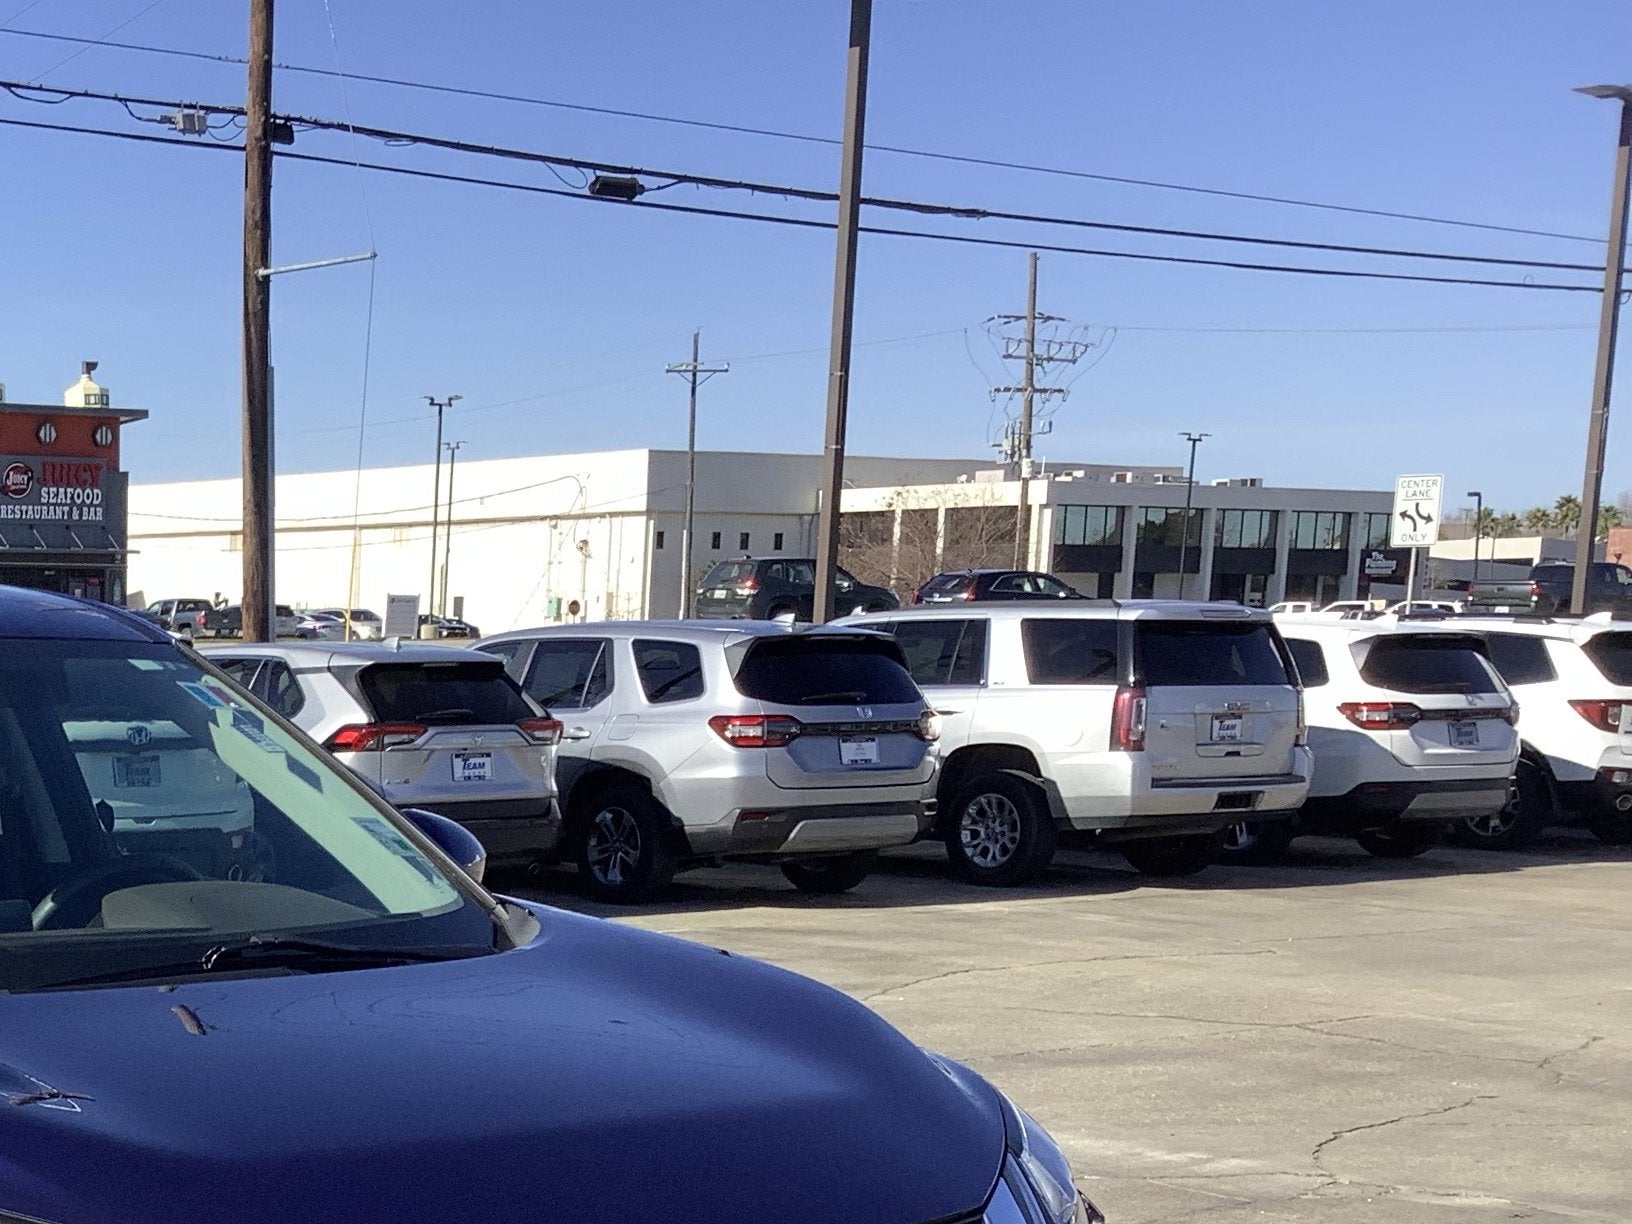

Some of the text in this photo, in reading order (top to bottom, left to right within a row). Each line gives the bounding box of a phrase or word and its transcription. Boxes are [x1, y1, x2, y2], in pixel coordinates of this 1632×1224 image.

[37, 463, 102, 486] JUICY
[1401, 479, 1438, 489] CENTER
[40, 487, 102, 505] SEAFOOD
[1405, 489, 1432, 498] LANE
[0, 505, 103, 521] RESTAURANT & BAR
[1401, 533, 1428, 542] ONLY
[462, 758, 486, 771] TEAM
